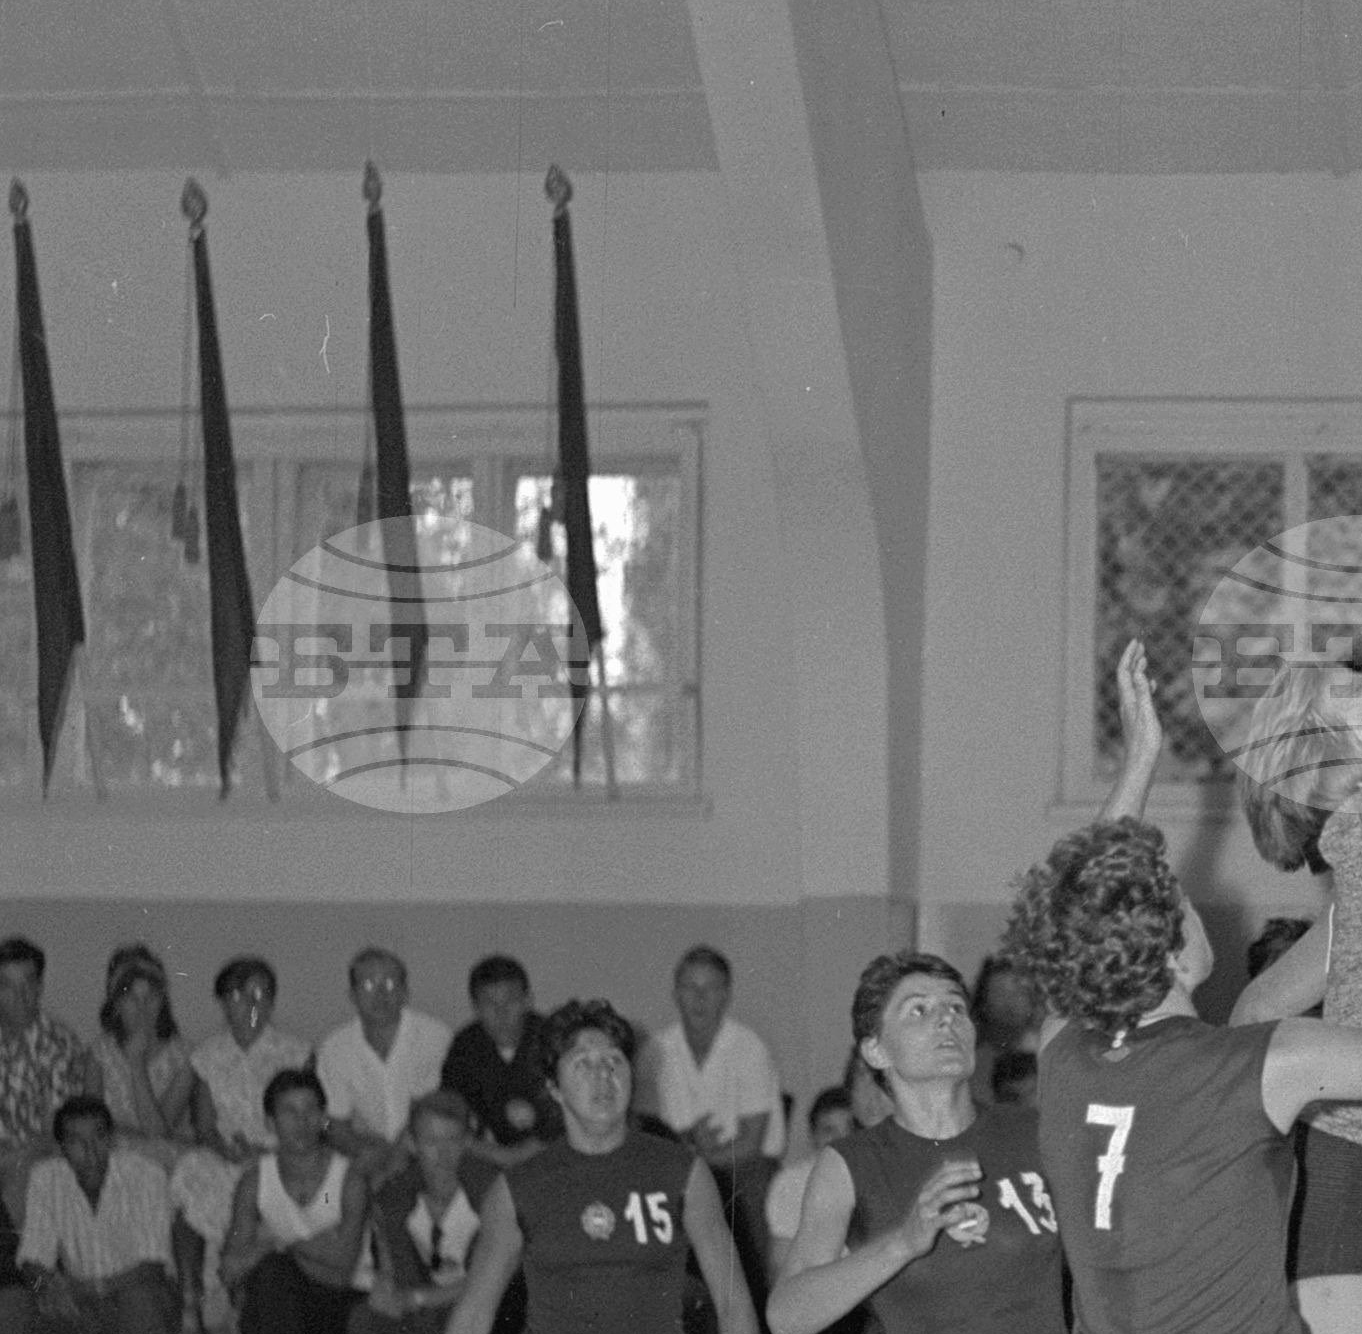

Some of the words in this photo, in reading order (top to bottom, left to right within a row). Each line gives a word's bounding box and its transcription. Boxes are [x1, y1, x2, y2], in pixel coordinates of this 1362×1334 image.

[1085, 1104, 1135, 1230] 7
[624, 1191, 673, 1244] 15
[998, 1172, 1058, 1234] 13
